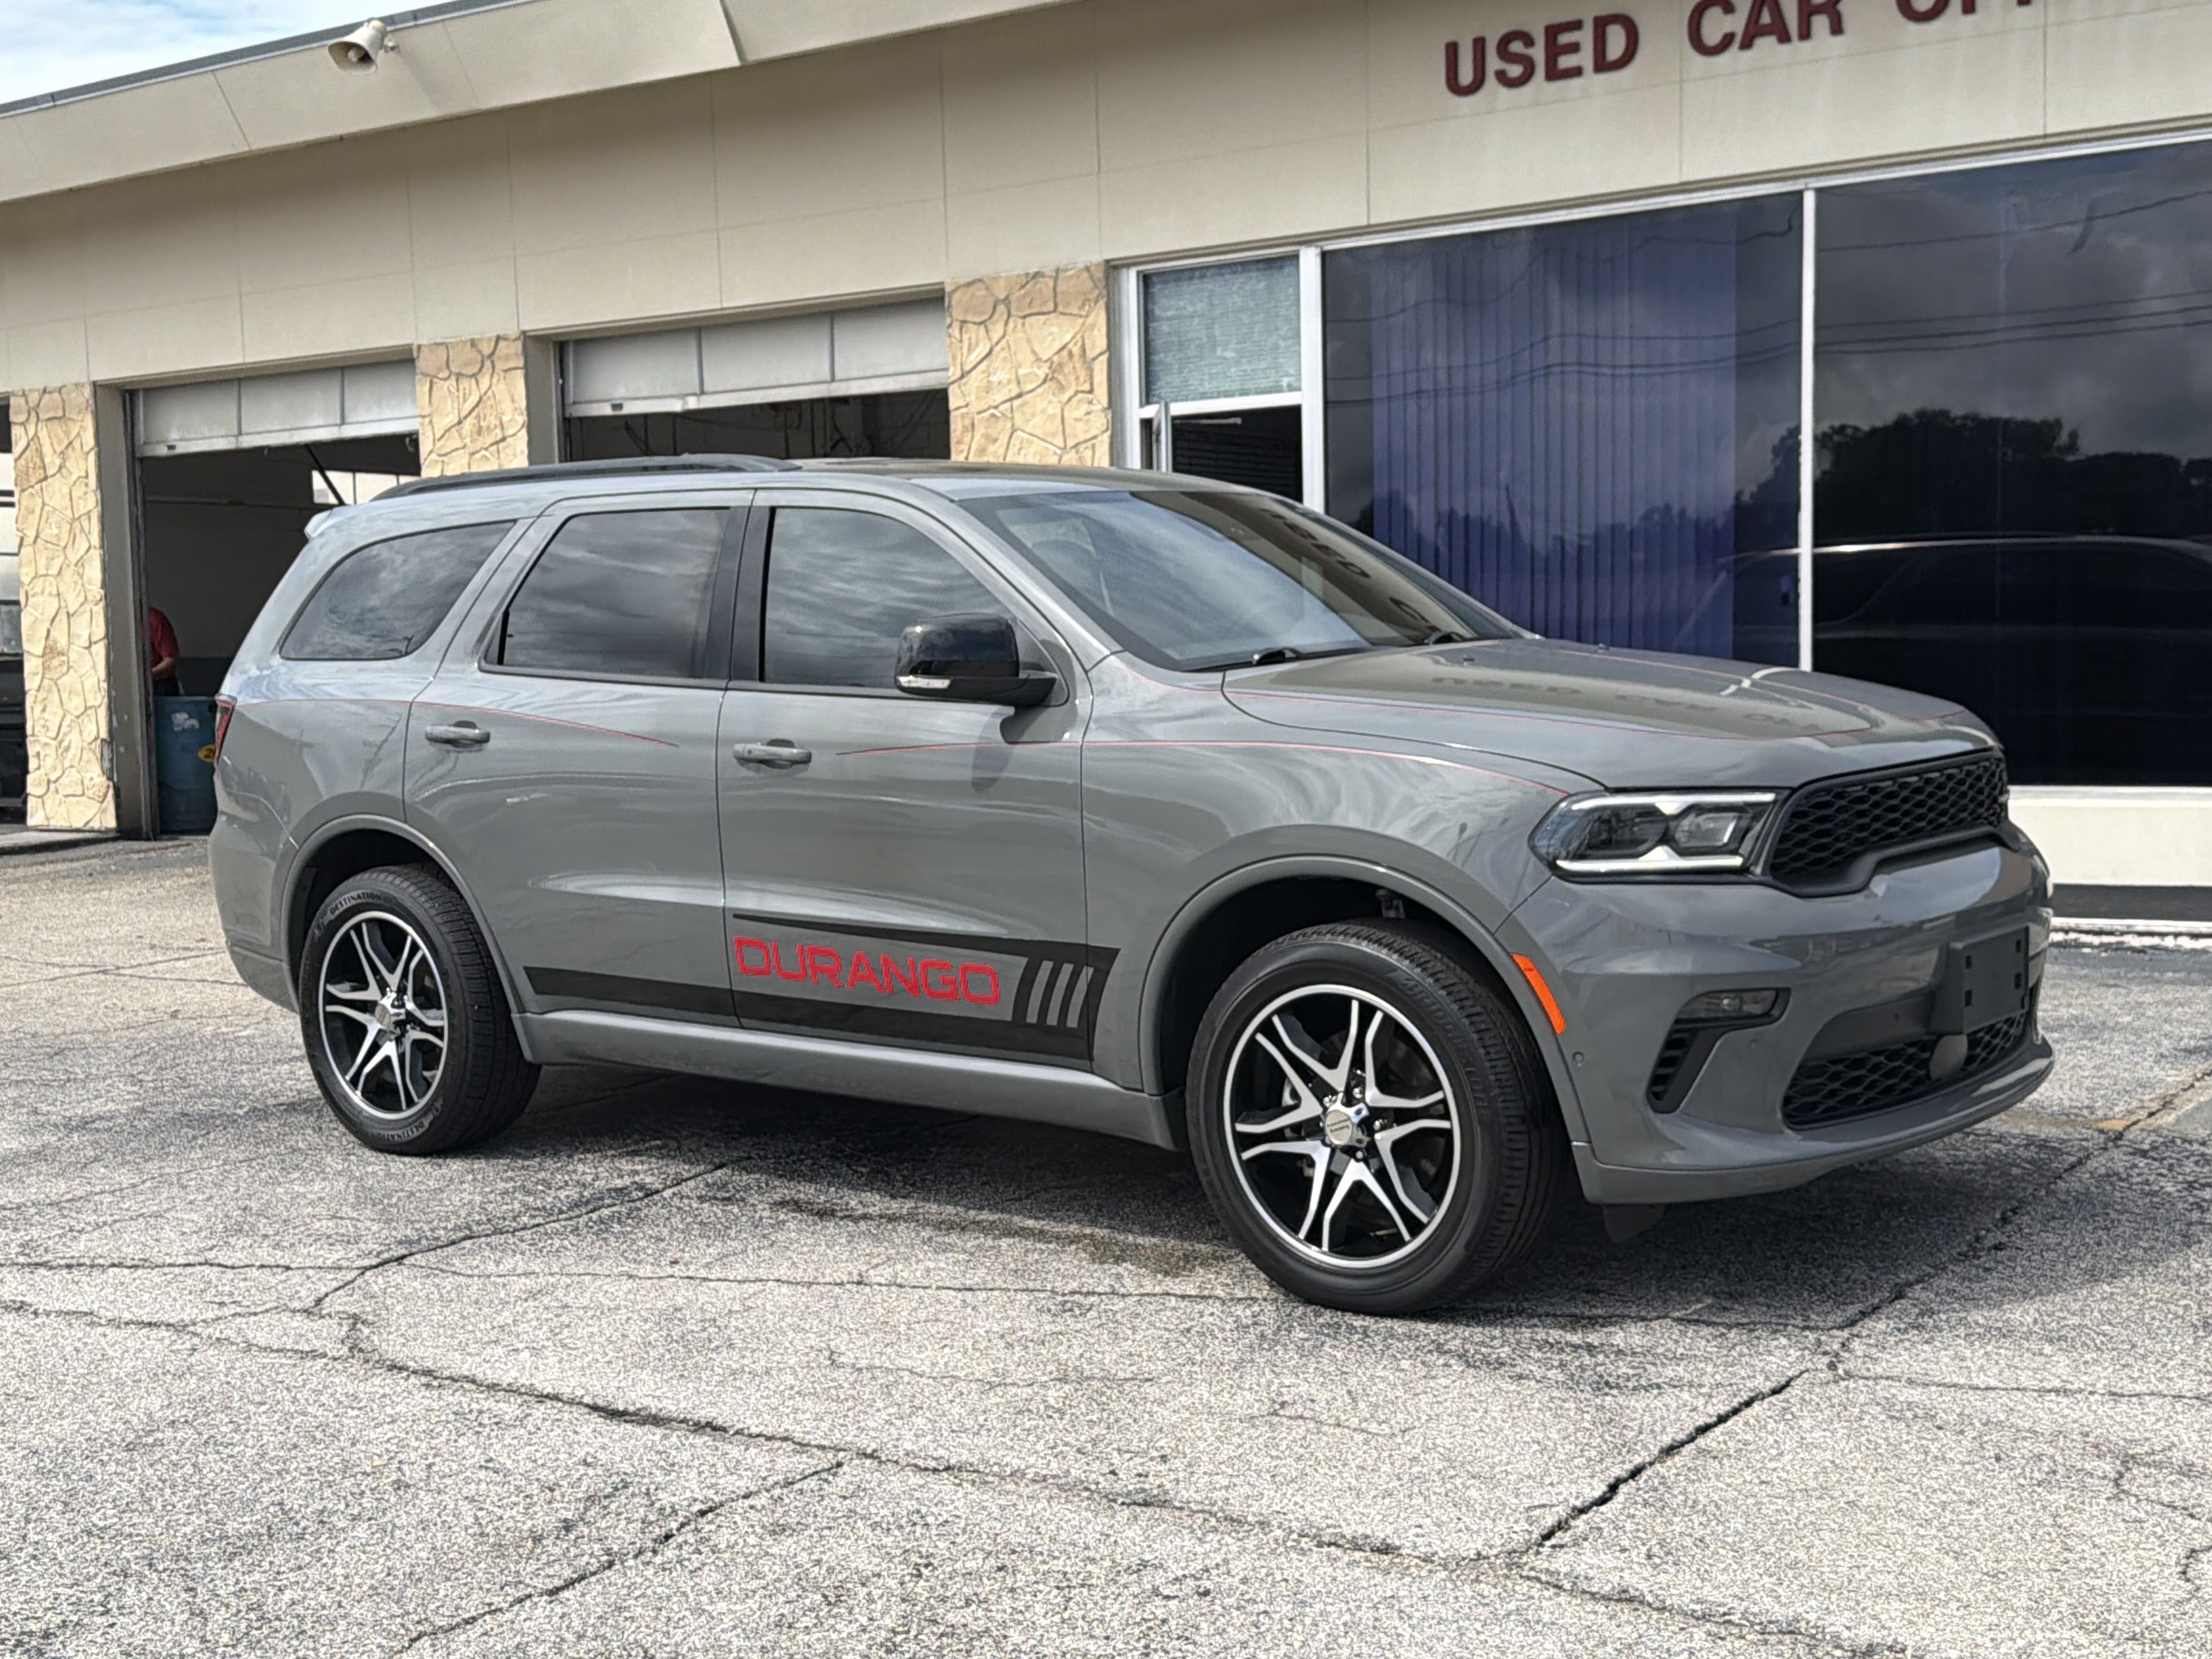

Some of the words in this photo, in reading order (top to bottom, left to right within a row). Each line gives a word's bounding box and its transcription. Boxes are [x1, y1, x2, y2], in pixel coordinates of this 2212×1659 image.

[1444, 13, 1639, 97] USED
[1687, 0, 1845, 56] CAR
[330, 891, 382, 916] DESTINATION
[733, 936, 1001, 1006] DURANGO
[371, 1120, 426, 1142] DESTINATIO
